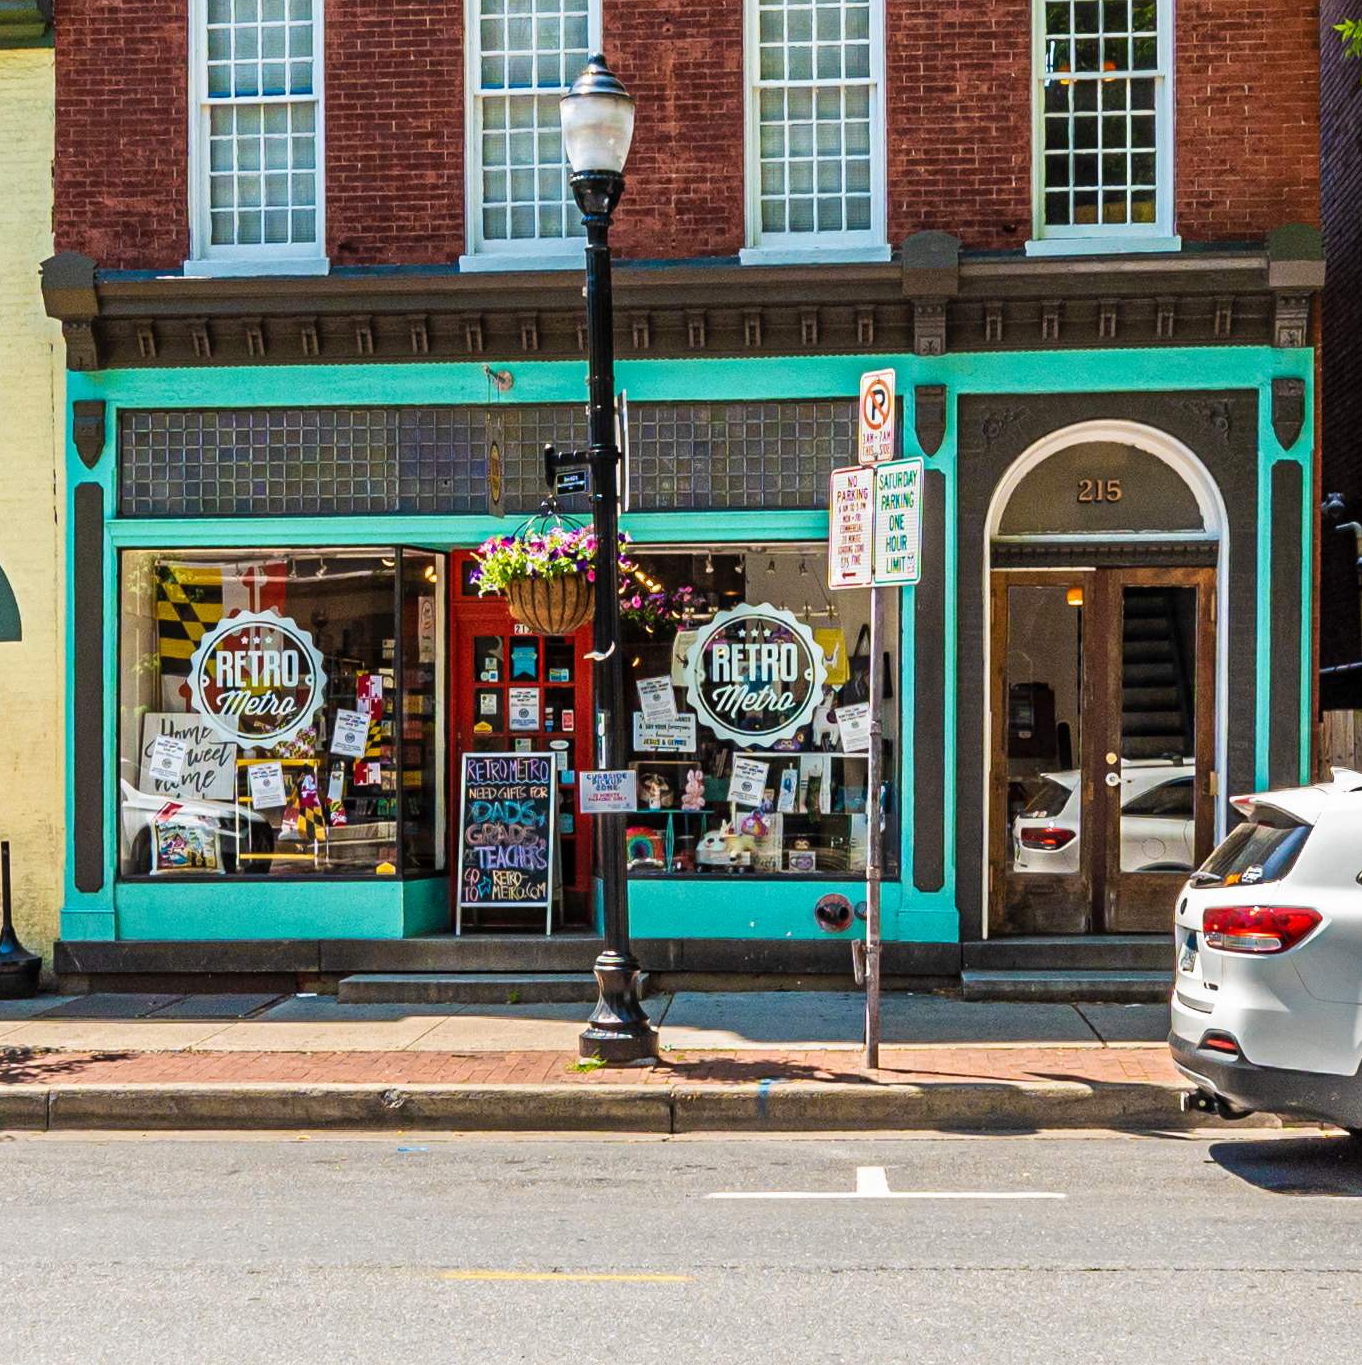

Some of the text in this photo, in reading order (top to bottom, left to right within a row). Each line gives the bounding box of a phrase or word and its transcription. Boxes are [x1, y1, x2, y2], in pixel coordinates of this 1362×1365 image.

[847, 476, 858, 488] NO
[879, 470, 917, 490] SATURDAY
[837, 487, 869, 503] PARKING
[1077, 479, 1122, 502] 215
[881, 491, 915, 511] PARKING
[889, 513, 905, 531] ONE
[886, 535, 908, 552] HOUR
[886, 556, 906, 573] LIMIT
[216, 650, 299, 688] RETRO
[712, 642, 798, 682] RETRO
[216, 689, 297, 718] Metro
[712, 684, 797, 718] Metro
[467, 758, 549, 783] RETRO METRO
[469, 786, 549, 799] NEED GIFTS FOR
